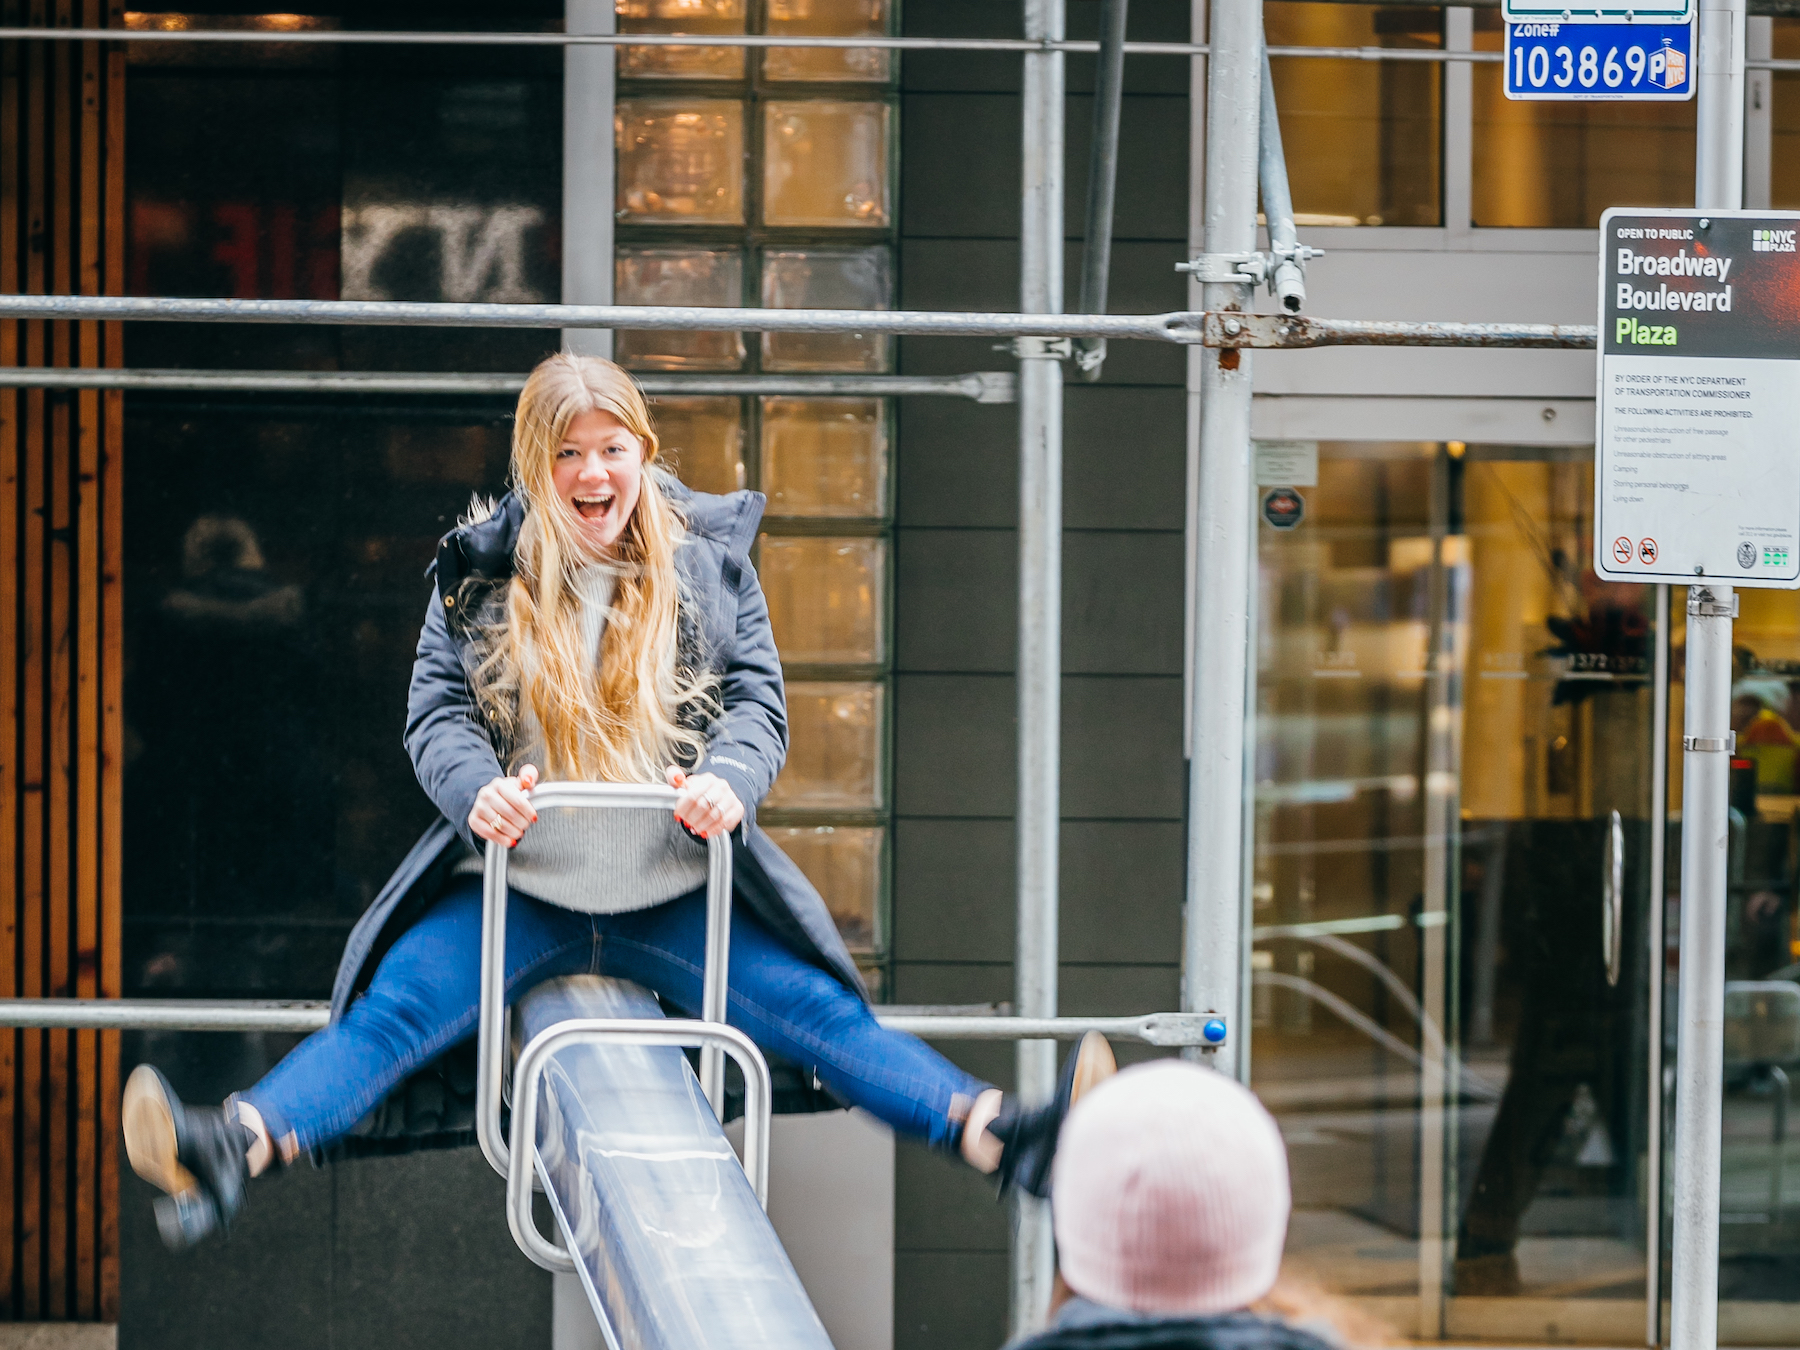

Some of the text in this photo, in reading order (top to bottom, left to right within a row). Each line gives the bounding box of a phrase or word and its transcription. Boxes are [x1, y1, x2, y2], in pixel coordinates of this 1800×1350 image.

[1514, 24, 1560, 38] Zone#
[1513, 45, 1647, 88] 103869
[1667, 66, 1685, 86] NYC
[1617, 228, 1694, 240] OPEN TO PUBLIC
[1770, 229, 1797, 244] NYC
[1770, 243, 1797, 252] PLAZA
[1617, 248, 1732, 283] Broadway
[1616, 282, 1732, 312] Boulevard
[1616, 317, 1678, 346] Plaza
[1614, 374, 1747, 386] BY ORDER OF THE NYC DEPARTMENT
[1614, 387, 1751, 400] OF TRANSPORTATION COMMISSIONER
[1614, 406, 1754, 419] THE FOLLOWING ACTIVITIES ARE PROHIBITED:
[1613, 464, 1638, 474] Camping
